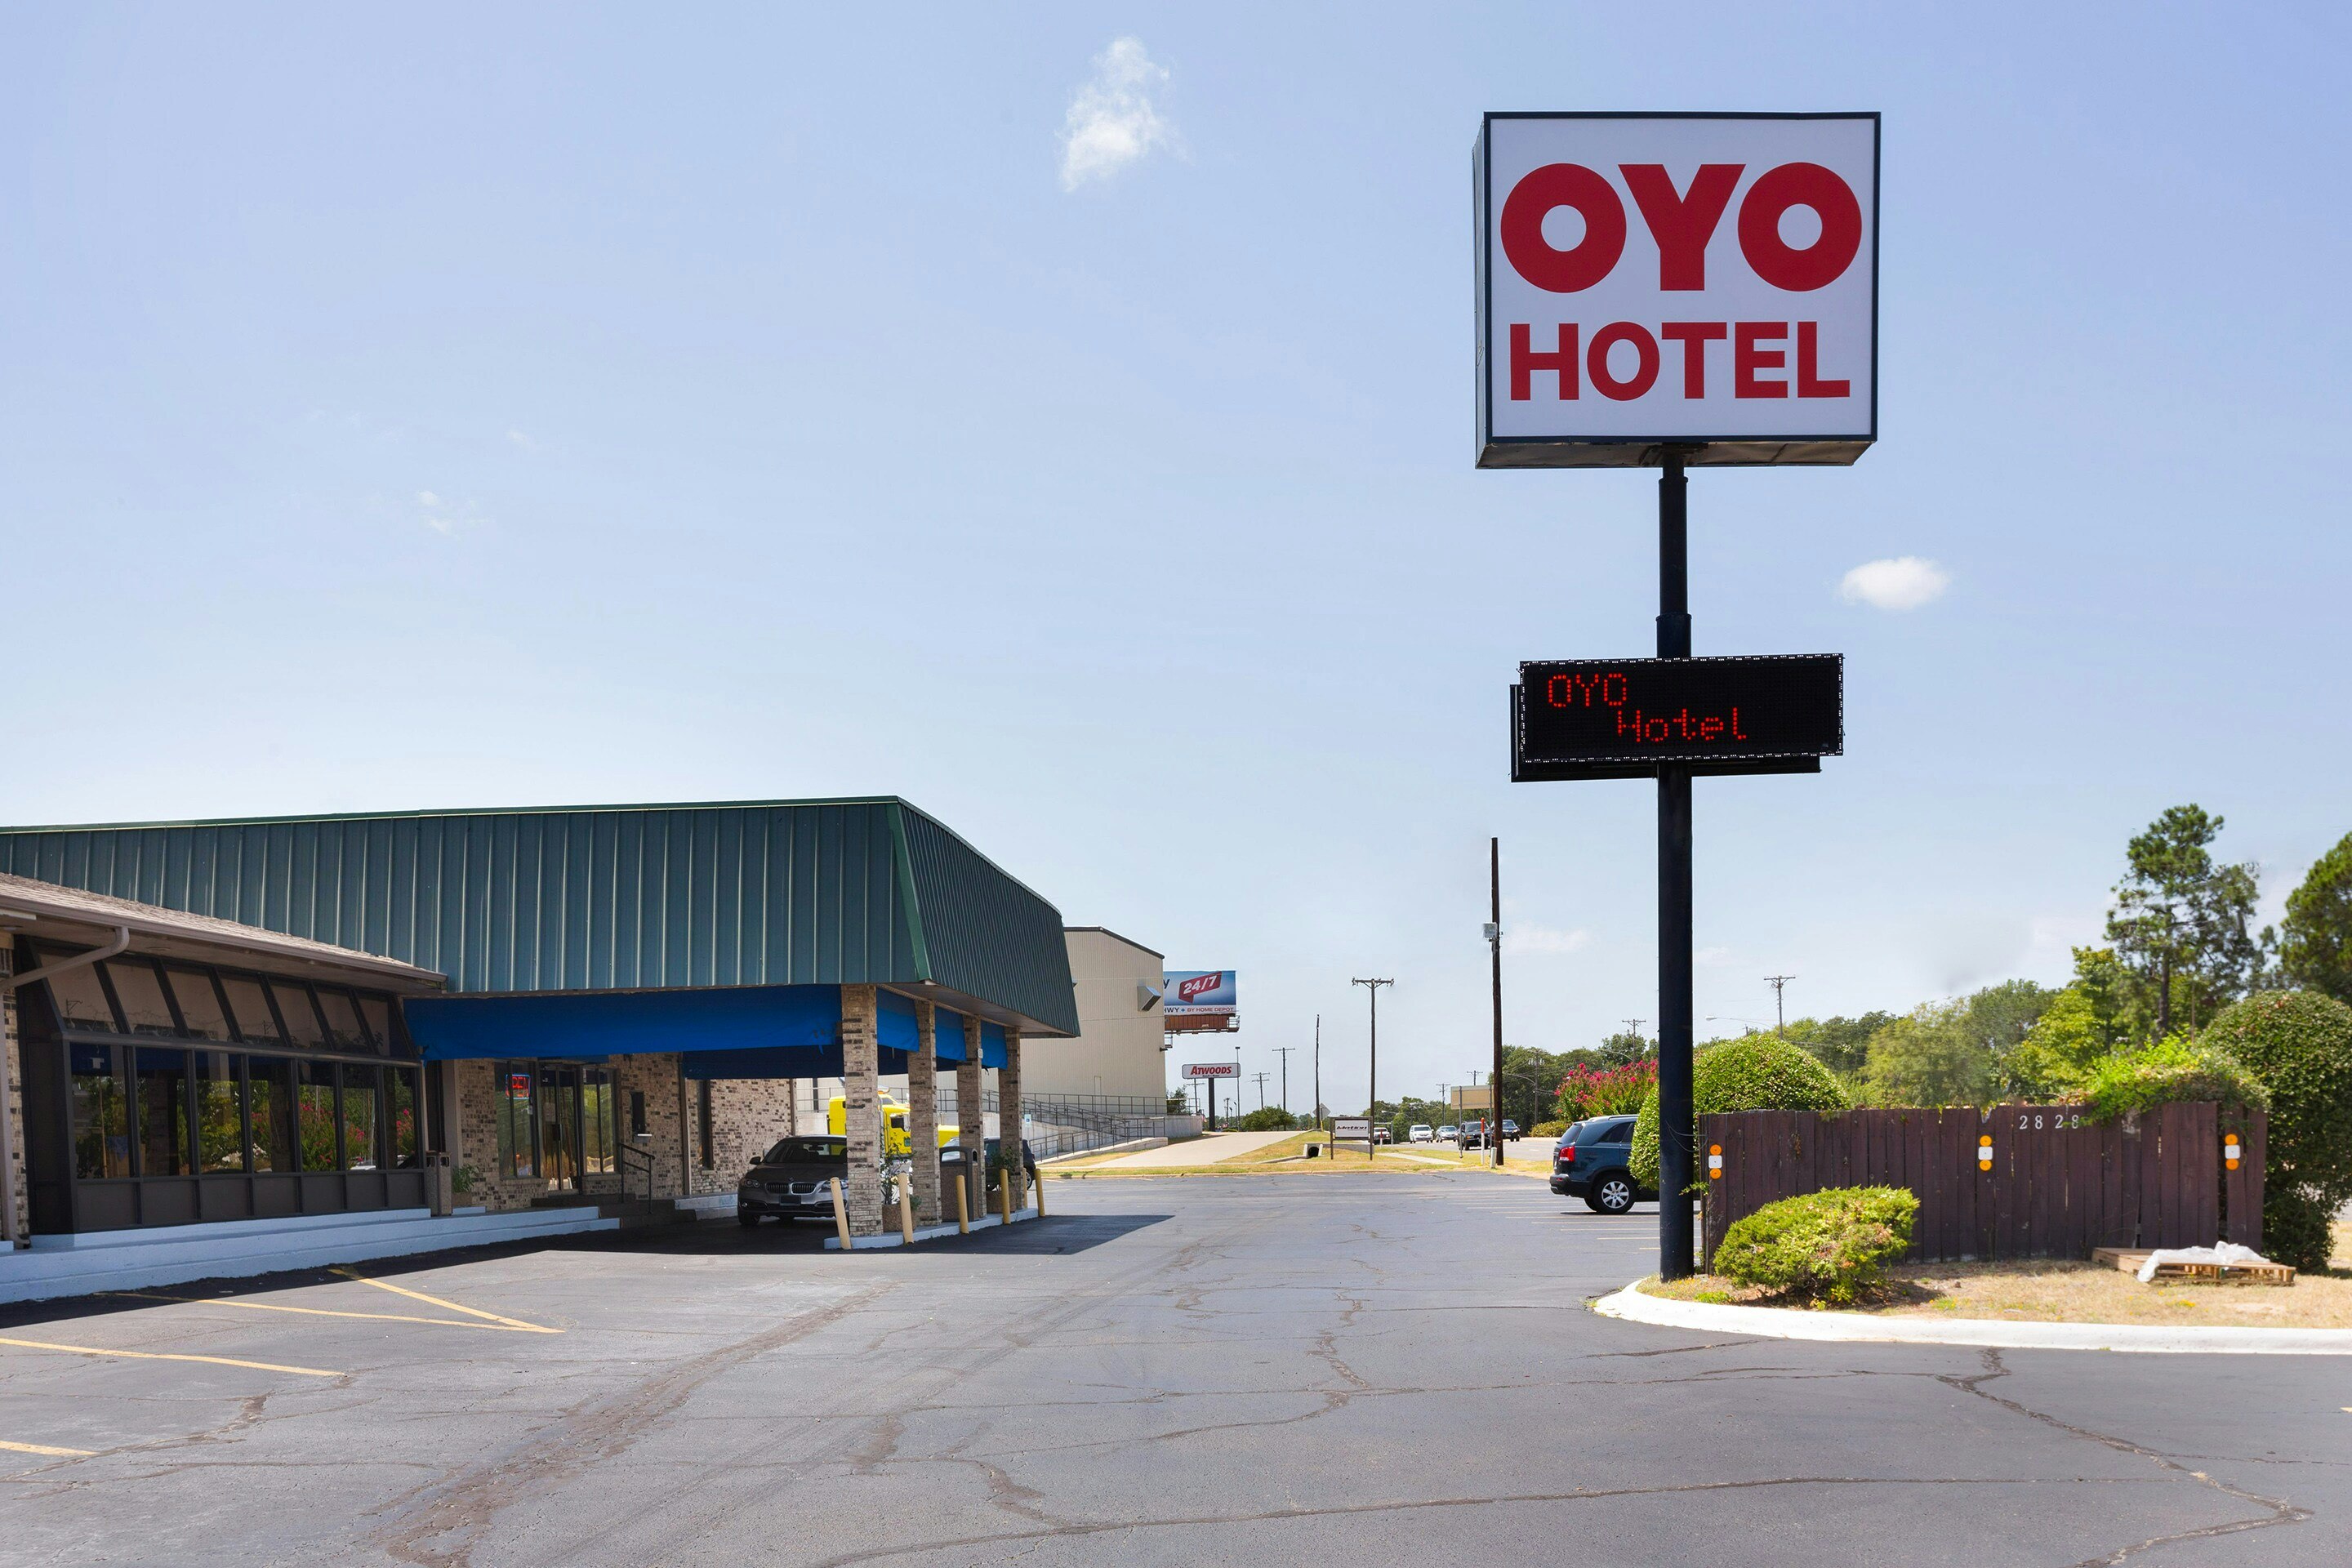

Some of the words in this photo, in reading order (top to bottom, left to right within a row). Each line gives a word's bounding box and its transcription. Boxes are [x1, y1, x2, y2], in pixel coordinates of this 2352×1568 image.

[1500, 162, 1863, 294] OYO
[1509, 321, 1851, 401] HOTEL
[1548, 673, 1627, 708] OYO
[1618, 707, 1747, 743] Hotel
[1183, 975, 1218, 995] 24/7
